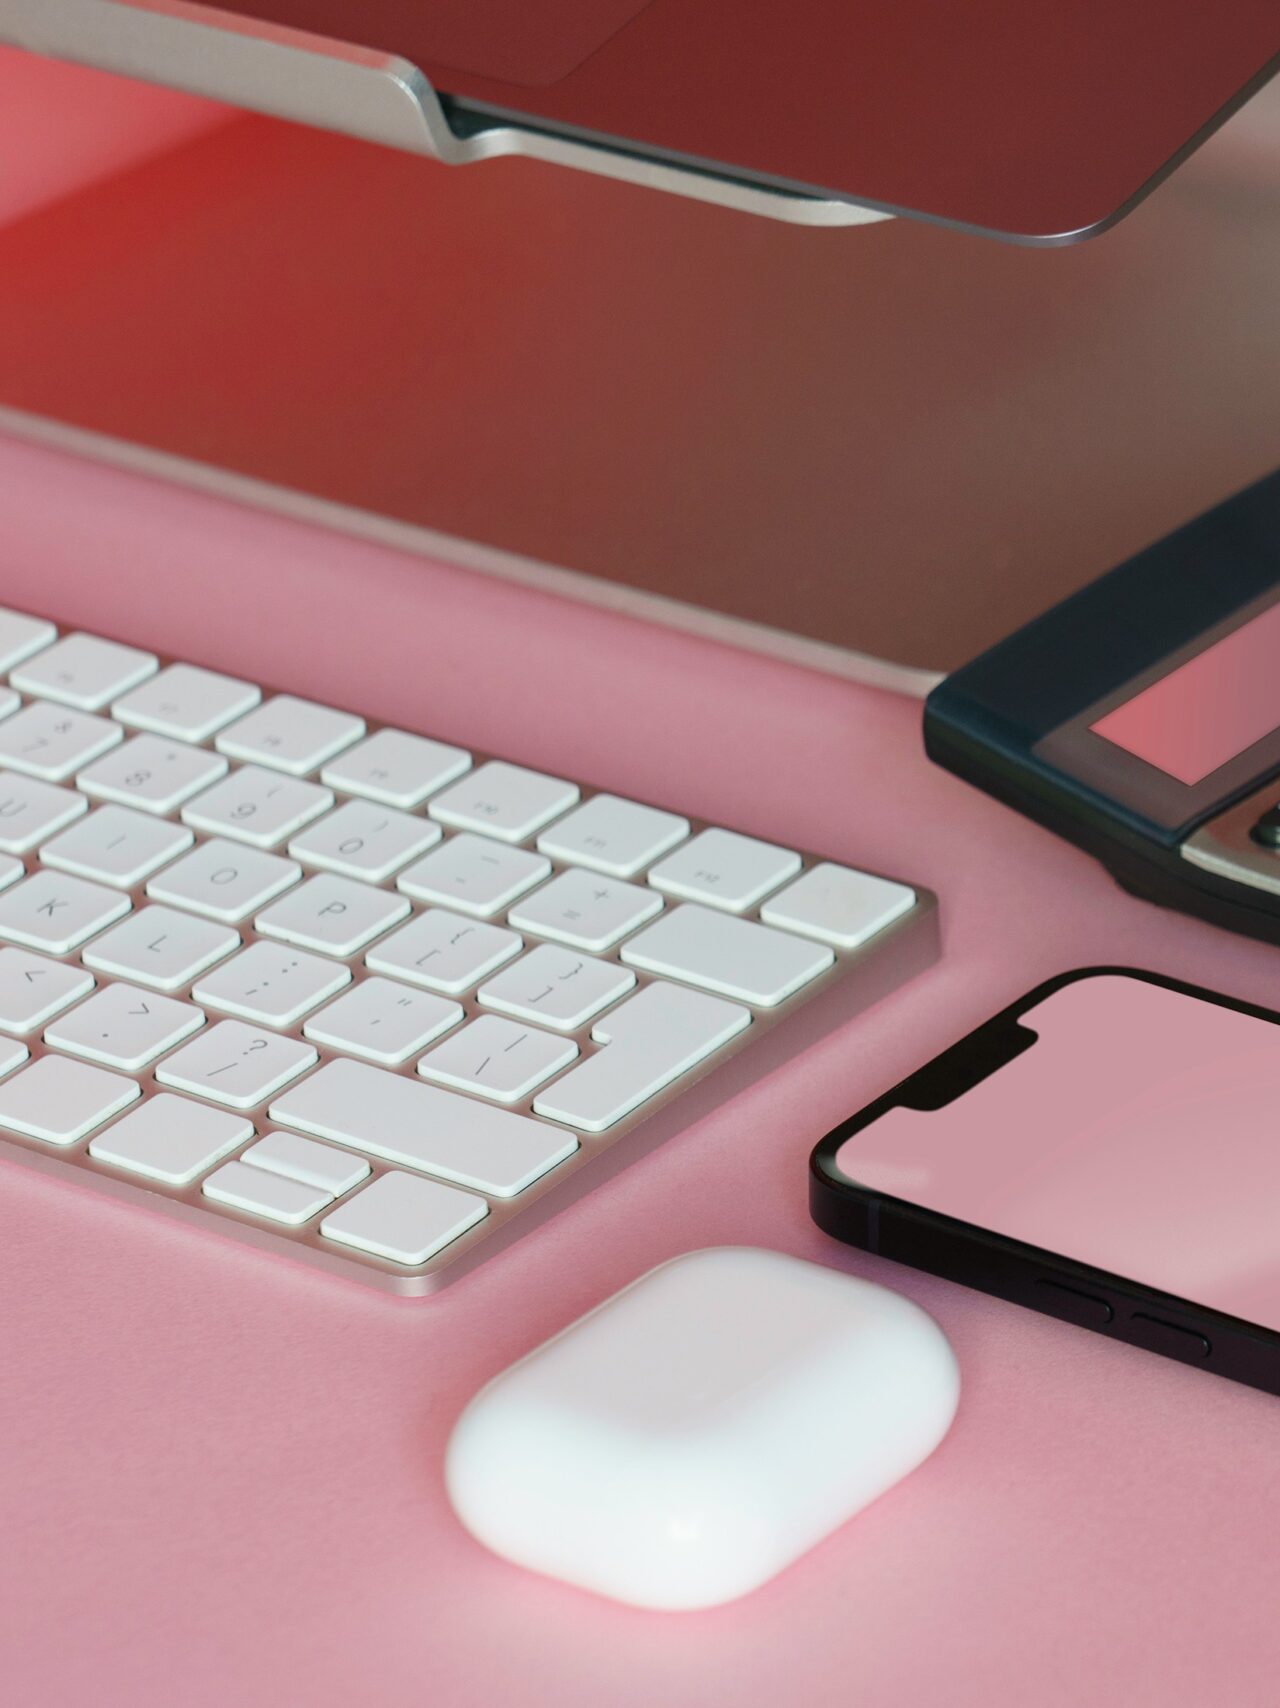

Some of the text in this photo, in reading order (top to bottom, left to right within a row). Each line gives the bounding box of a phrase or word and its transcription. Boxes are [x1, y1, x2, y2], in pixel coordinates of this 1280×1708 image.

[35, 897, 70, 918] K
[317, 901, 348, 917] P
[147, 934, 168, 953] L
[242, 1039, 269, 1056] ?
